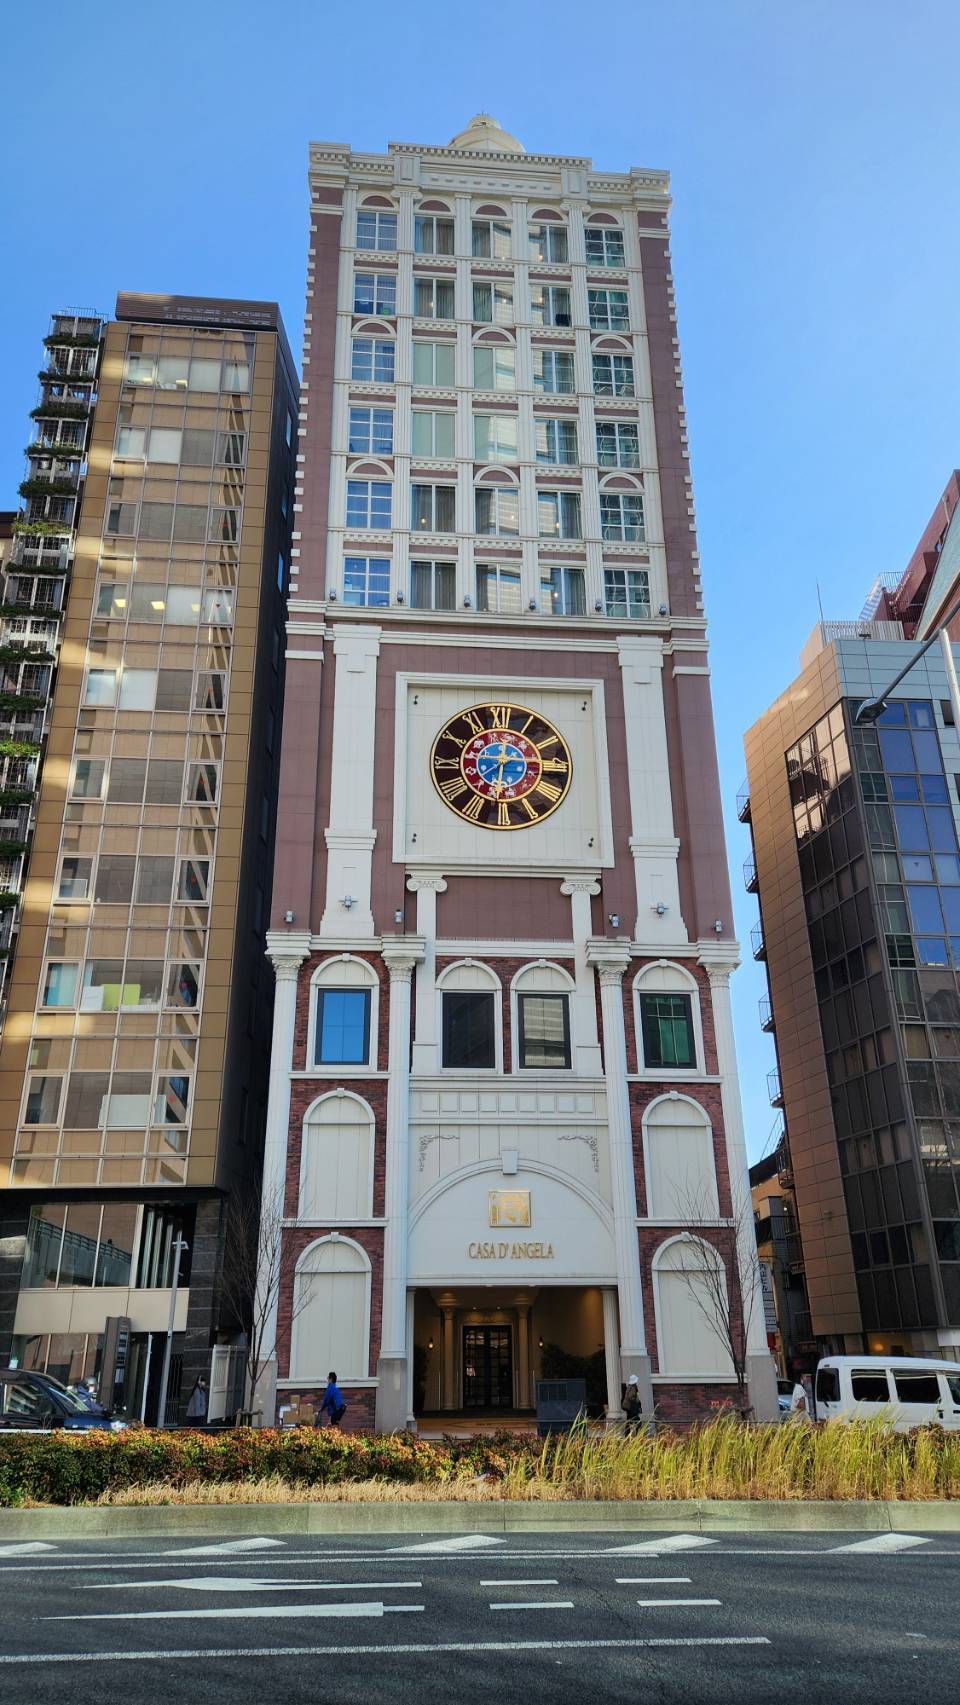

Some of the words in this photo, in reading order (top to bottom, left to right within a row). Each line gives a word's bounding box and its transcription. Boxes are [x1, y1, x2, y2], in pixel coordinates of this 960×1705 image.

[462, 711, 484, 735] XI
[490, 706, 511, 729] XII
[520, 715, 534, 734] I
[442, 730, 467, 748] X
[536, 735, 559, 750] II
[434, 756, 460, 769] IX
[439, 776, 468, 801] VIII
[461, 794, 485, 819] VII
[497, 802, 511, 825] VI
[521, 797, 539, 820] V
[468, 1242, 497, 1259] CASA
